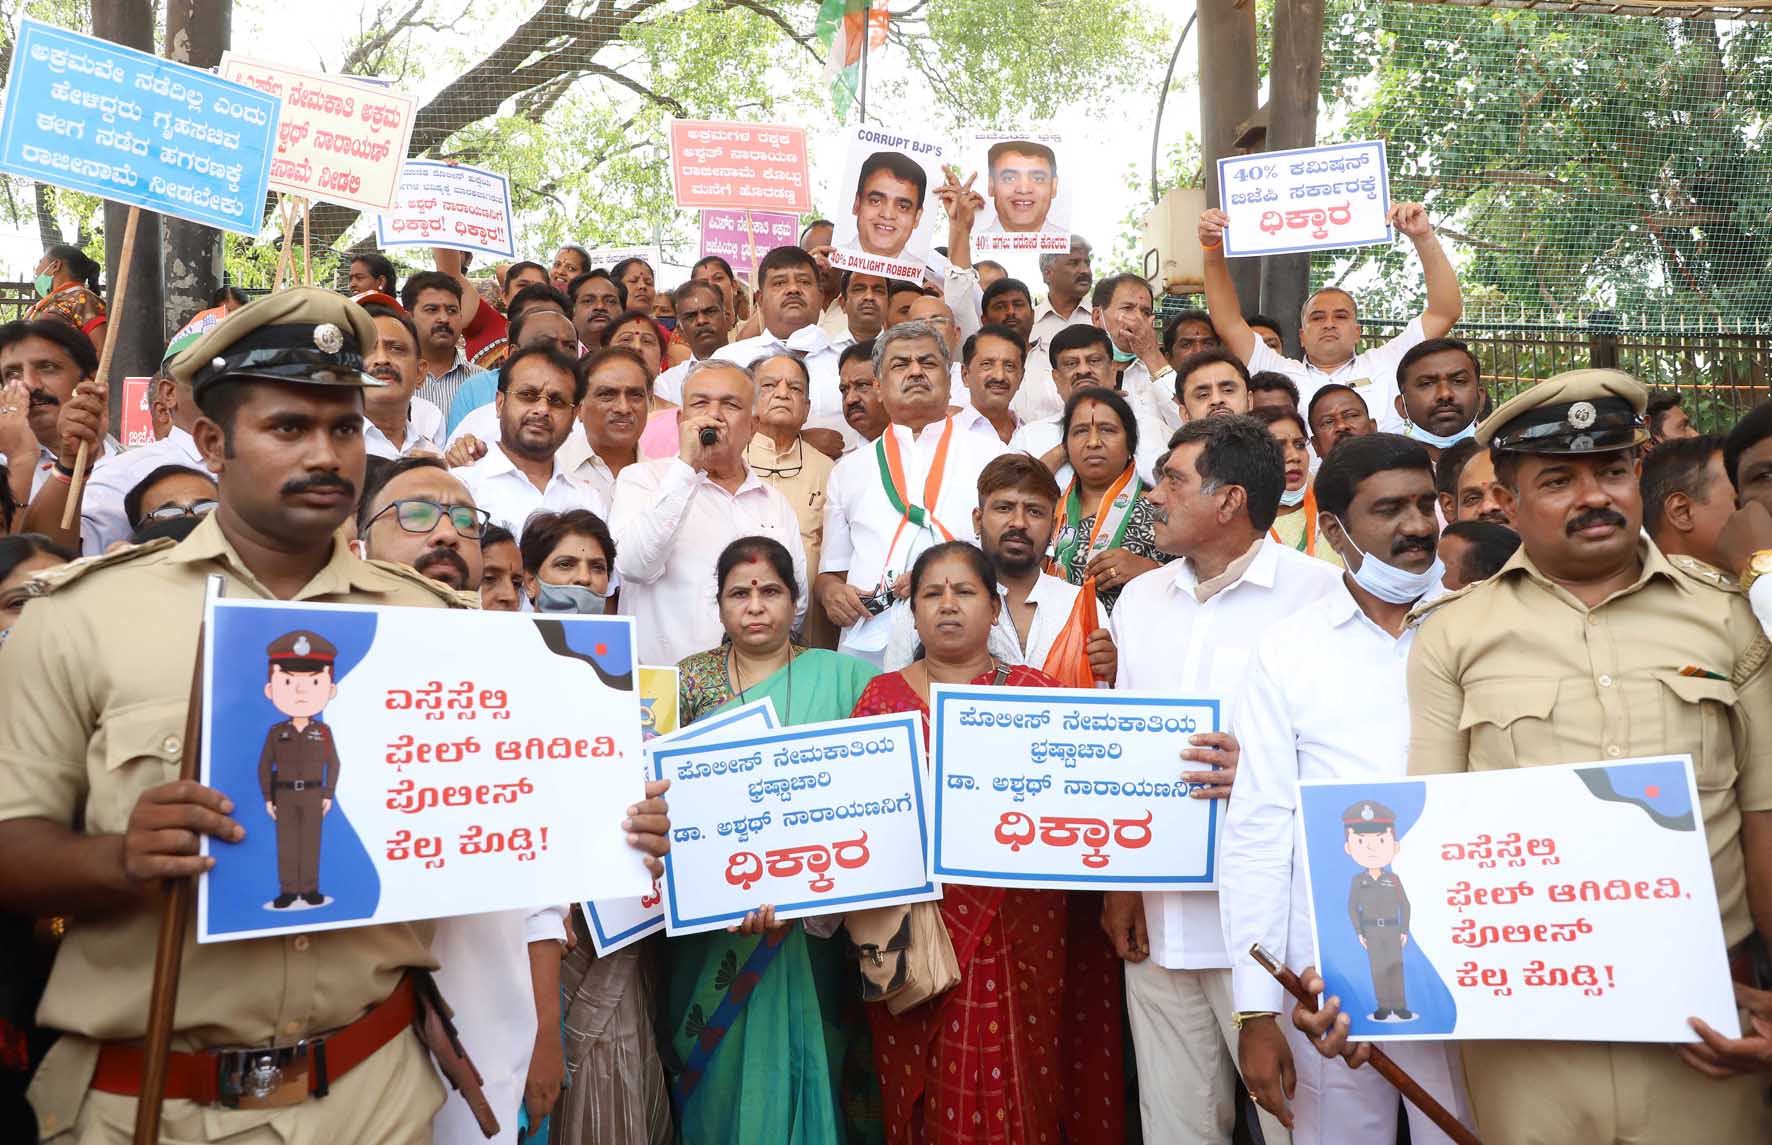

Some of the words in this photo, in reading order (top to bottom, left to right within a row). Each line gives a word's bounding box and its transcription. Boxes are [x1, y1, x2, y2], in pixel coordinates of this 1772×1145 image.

[31, 42, 125, 83] ಅಕ್ರಮವೇ
[135, 71, 203, 112] ನಡೆದಿಲ್ಲ
[213, 97, 267, 126] ಎಂದು
[51, 81, 143, 124] ಹೇಳಿದ್ದರು
[153, 110, 240, 150] ಗೃಹಸಚಿವ
[288, 82, 355, 118] ನೇಮಕಾತಿ
[361, 102, 401, 133] ಅಕ್ರಮ
[36, 112, 85, 139] ಈಗ
[95, 128, 149, 156] ನಡೆದ
[160, 145, 243, 193] ಹಗರಣಕ್ಕೆ
[314, 129, 391, 162] ನಾರಾಯಣ್
[687, 128, 750, 144] ಅಕ್ರಮಗಳ
[857, 129, 910, 150] CORRUPT
[912, 141, 942, 157] BJP'S
[682, 166, 756, 178] ರಾಜೀನಾಮೆ
[730, 149, 798, 163] ನಾರಾಯಣ
[1233, 164, 1278, 182] 40%
[1289, 153, 1369, 176] ಕಮಿಷನ್
[21, 143, 139, 187] ರಾಜೀನಾಮೆ
[150, 176, 244, 217] ನೀಡಬೇಕು
[317, 166, 361, 193] ನೀಡಲಿ
[691, 183, 732, 195] ಮನೆಗೆ
[1231, 187, 1278, 205] ಬಿಜೆಪಿ
[1290, 176, 1377, 200] ಸರ್ಕಾರಕ್ಕೆ
[392, 215, 446, 237] ಧಿಕ್ಕಾರ!
[455, 221, 505, 245] ಧಿಕ್ಕಾರ!!
[1259, 200, 1351, 240] ಧಿಕ್ಕಾರ
[828, 251, 847, 265] 40%
[848, 256, 885, 272] DAYLIGHT
[886, 263, 922, 279] ROBBERY
[385, 680, 511, 721] ಎಸ್ಸೆಸ್ಸೆಲ್ಸಿ
[960, 707, 1051, 728] ಪೊಲೀಸ್
[1063, 709, 1196, 733] ನೇಮಕಾತಿಯ
[385, 734, 481, 773] ಫೇಲ್
[495, 734, 624, 761] ಆಗಿದೀವಿ,
[677, 751, 762, 781] ಪೊಲೀಸ್
[773, 737, 895, 768] ನೇಮಕಾತಿಯ
[1031, 738, 1122, 768] ಭ್ರಷ್ಟಾಚಾರಿ
[386, 777, 535, 814] ಪೊಲೀಸ್
[748, 770, 832, 803] ಭ್ರಷ್ಟಾಚಾರಿ
[946, 773, 980, 791] ಡಾ.
[992, 773, 1052, 802] ಅಶ್ವಥ್
[673, 825, 706, 843] ಡಾ.
[717, 811, 772, 843] ಅಶ್ವಥ್
[783, 792, 912, 829] ನಾರಾಯಣನಿಗೆ
[386, 831, 446, 870] ಕೆಲ್ಸ
[459, 825, 549, 862] ಕೊಡ್ಸಿ!
[994, 809, 1152, 869] ಧಿಕ್ಕಾರ
[1441, 831, 1561, 870] ಎಸ್ಸೆಸ್ಸೆಲ್ಸಿ
[725, 829, 870, 893] ಧಿಕ್ಕಾರ
[1446, 879, 1534, 915] ಫೇಲ್
[1548, 876, 1692, 903] ಆಗಿದೀವಿ,
[1451, 917, 1593, 950] ಪೊಲೀಸ್
[1455, 960, 1513, 997] ಕೆಲ್ಸ
[1522, 959, 1616, 997] ಕೊಡ್ಸಿ!
